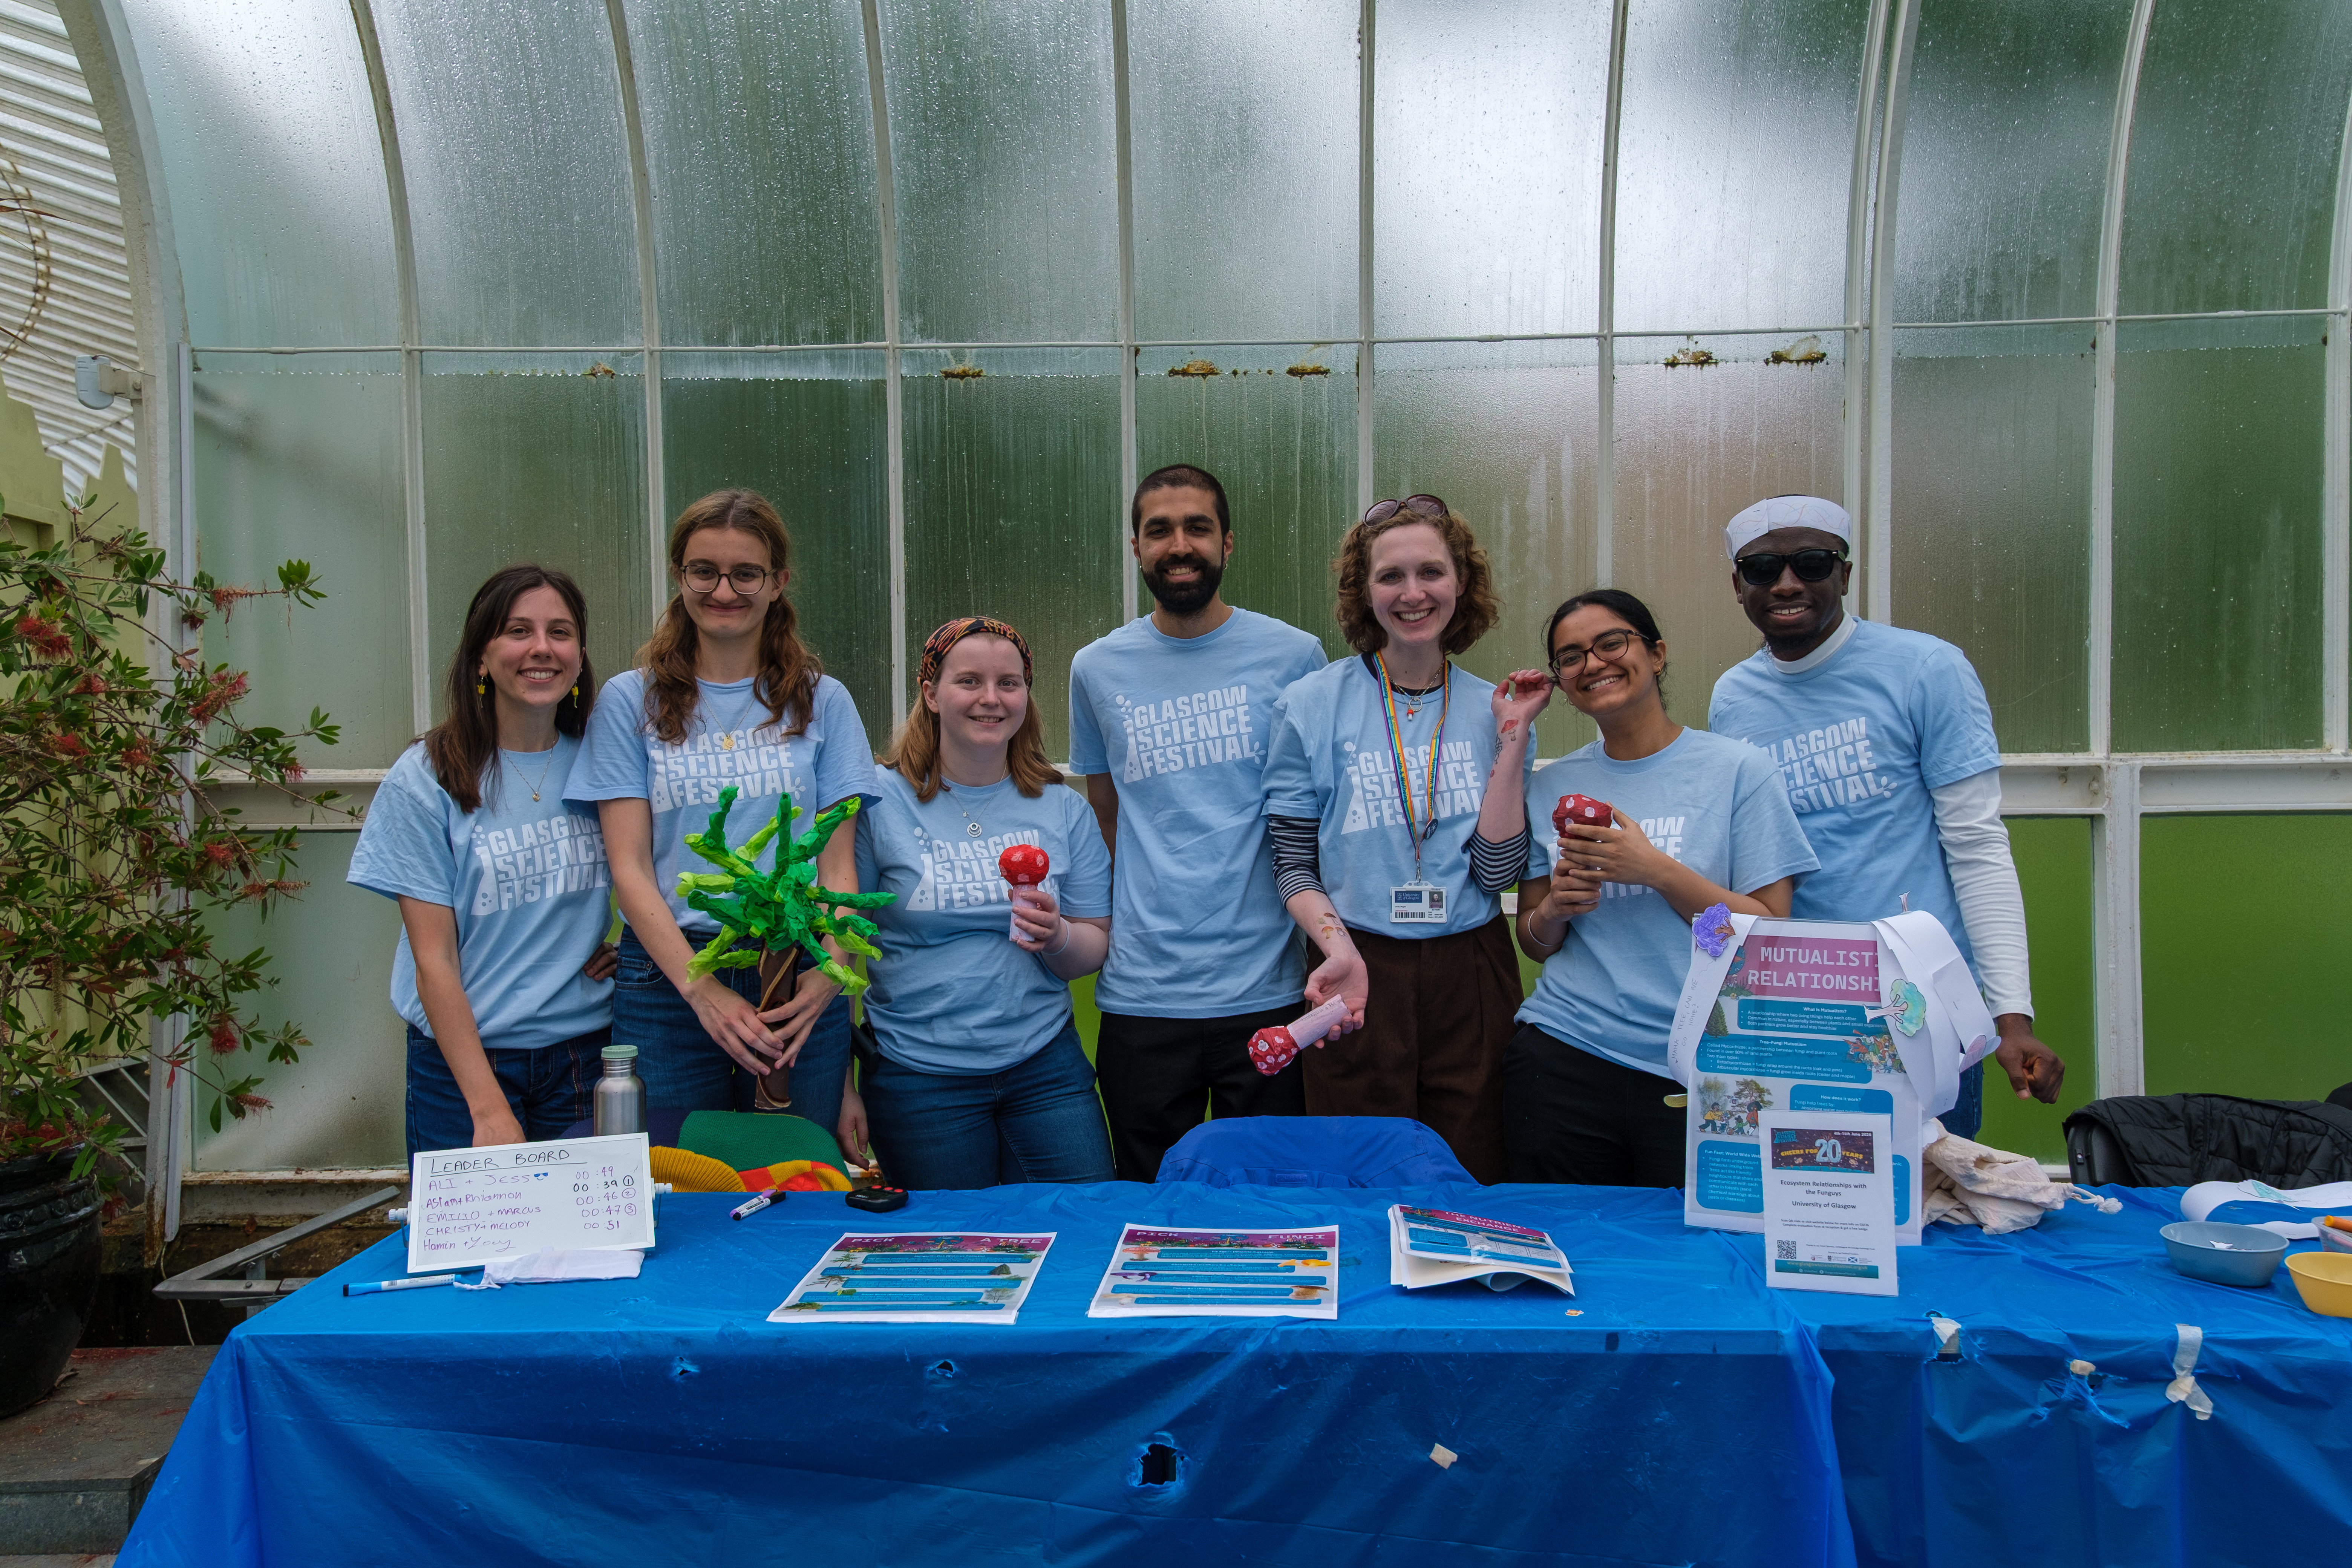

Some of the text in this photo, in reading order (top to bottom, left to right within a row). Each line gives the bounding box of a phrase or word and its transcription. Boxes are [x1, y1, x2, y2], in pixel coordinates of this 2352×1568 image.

[1134, 685, 1246, 729] GLASGOW
[1136, 705, 1253, 751] SCIENCE
[1761, 717, 1866, 765] LASGOW
[666, 743, 795, 780] SCIENCE
[1139, 735, 1256, 778] FESTIVAL
[1779, 740, 1877, 791] CIENCE
[1362, 761, 1481, 800] SCENCE
[1790, 772, 1884, 814] STIVAL
[1367, 789, 1481, 828] FESTVAL
[488, 814, 602, 856] GLASGOW
[932, 829, 1040, 863] GLASGOW
[495, 833, 608, 881] SCIENCE
[935, 858, 1001, 883] SCIE
[499, 864, 608, 910] FESTIVAL
[1691, 978, 1698, 990] WE
[1681, 1037, 1687, 1046] GO
[431, 1149, 570, 1174] LEADER BOARD
[1815, 1138, 1842, 1163] 20
[1842, 1151, 1864, 1159] YEARS
[429, 1178, 458, 1191] ALI
[485, 1174, 530, 1185] JESS
[427, 1210, 480, 1223] EMILIO
[498, 1206, 541, 1216] MARCUS
[490, 1220, 530, 1230] MELODY
[1456, 1217, 1519, 1233] EXCHANGE
[1470, 1216, 1527, 1230] NUTRIENT
